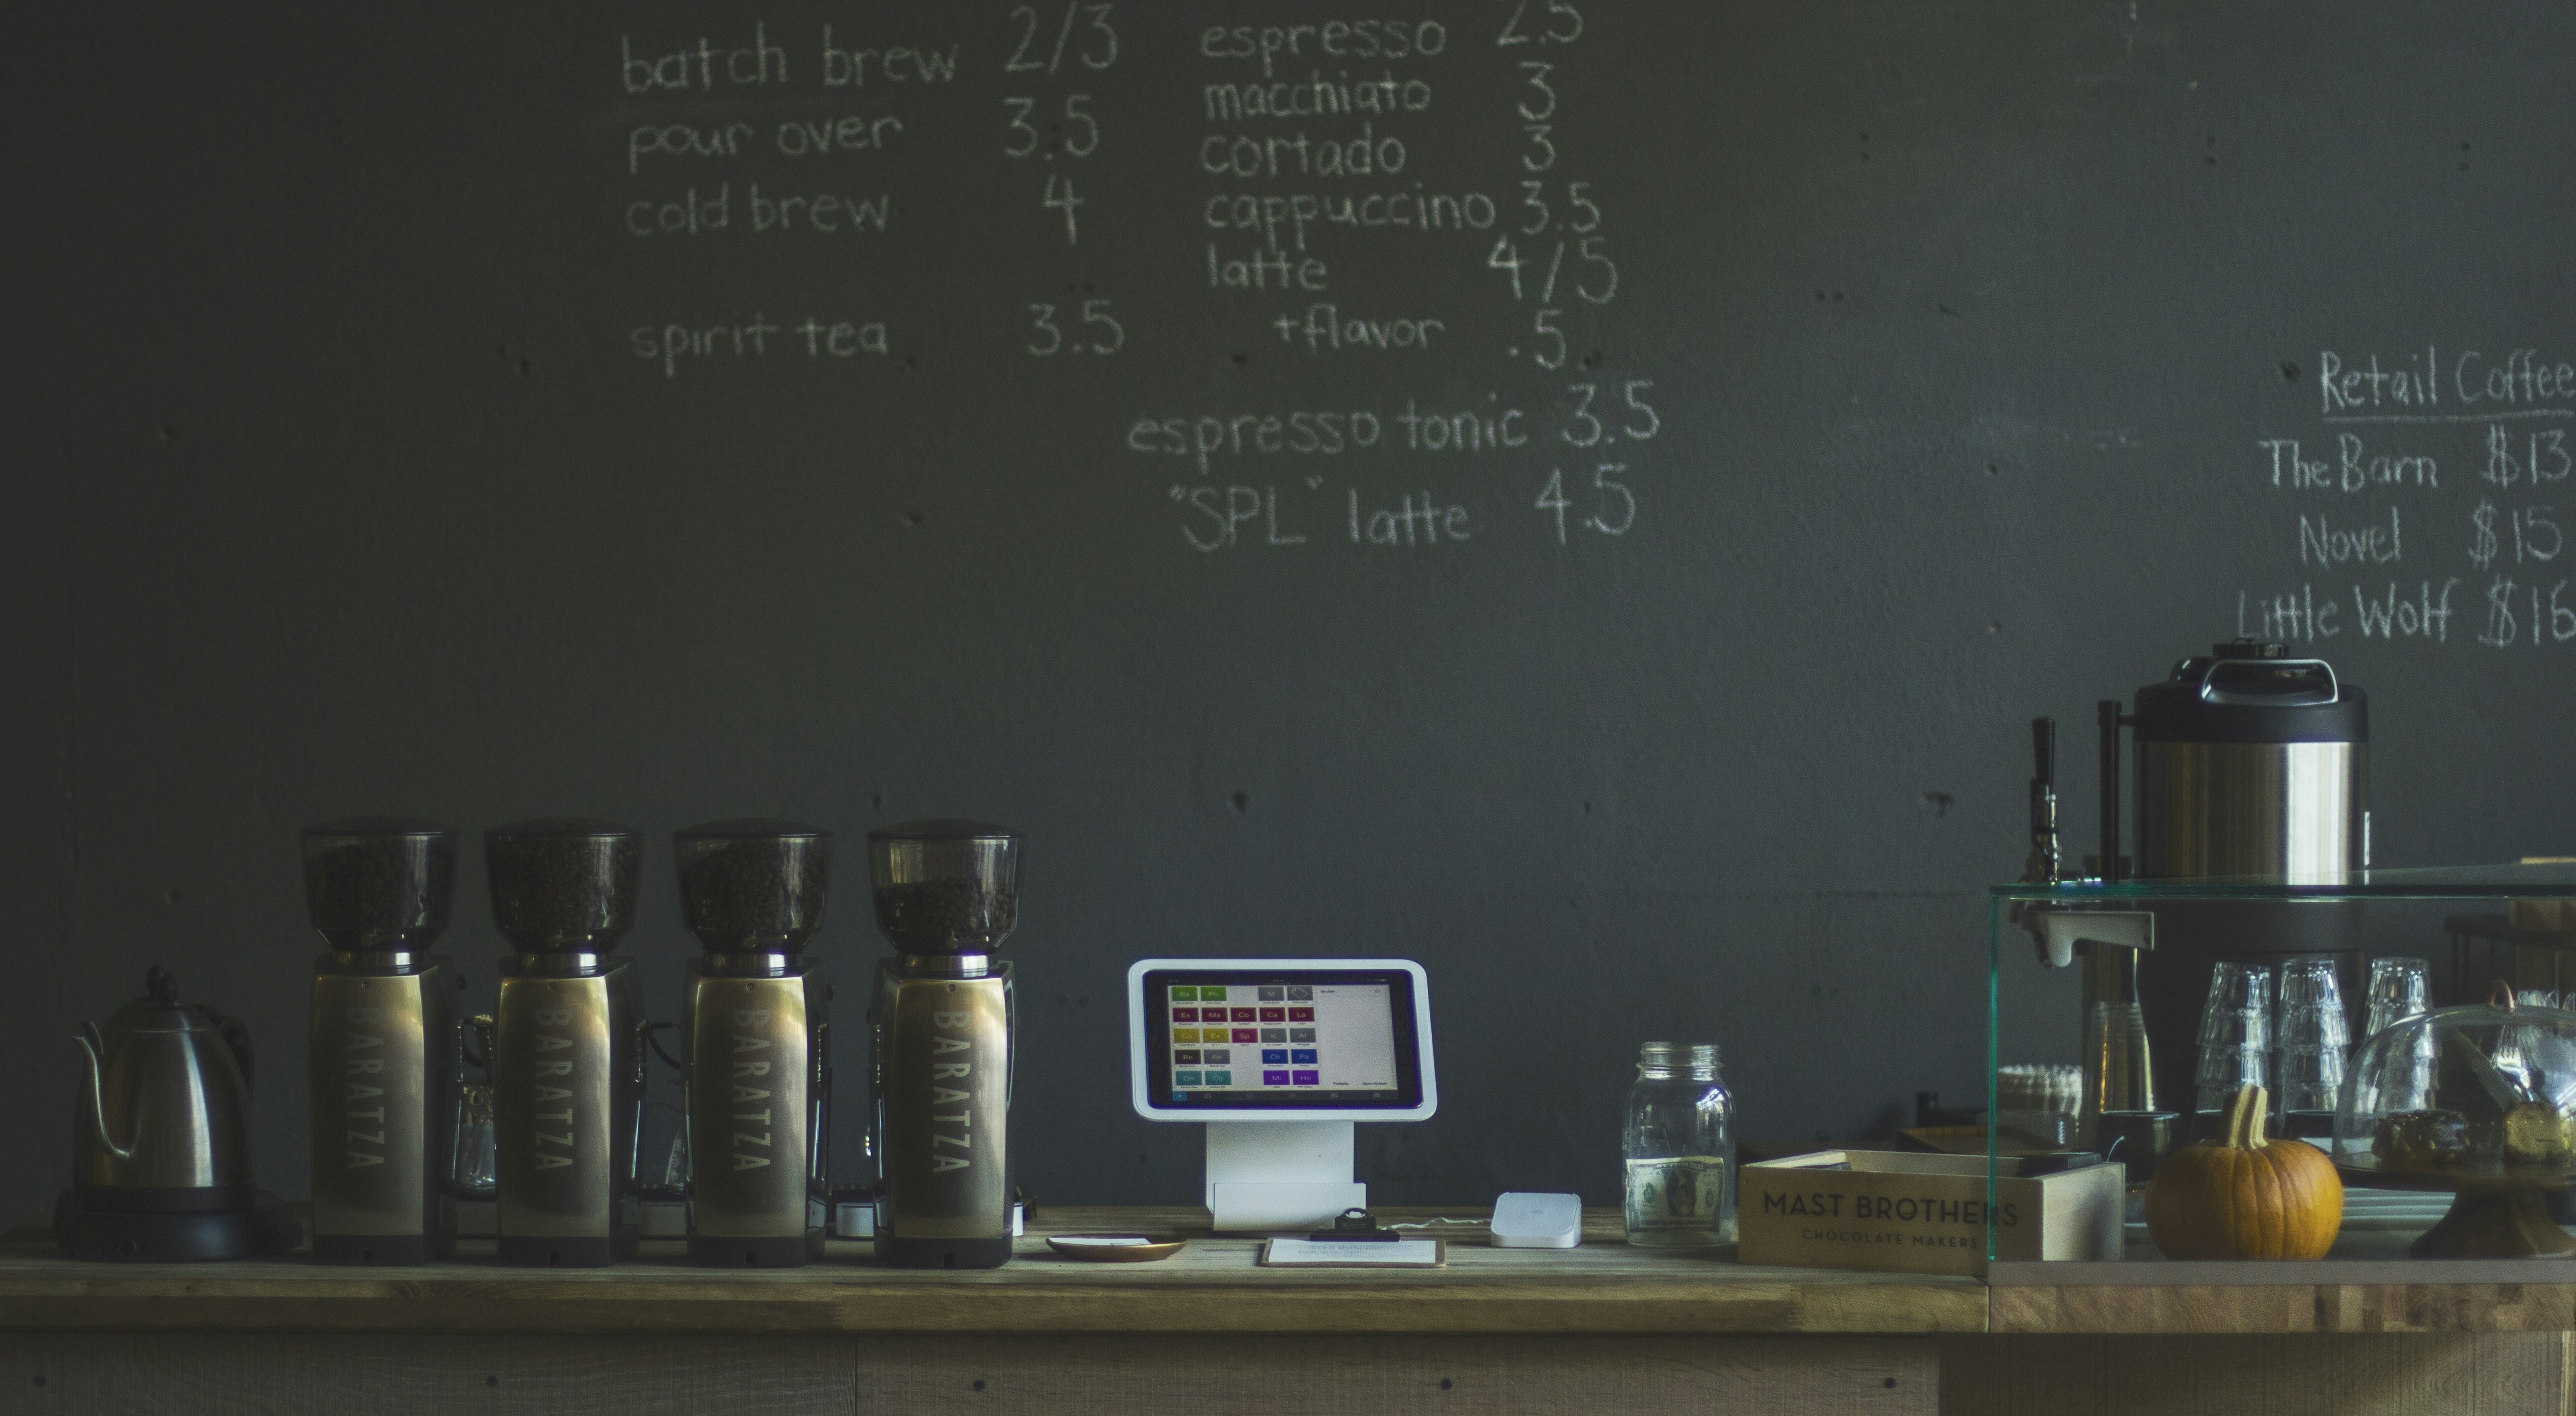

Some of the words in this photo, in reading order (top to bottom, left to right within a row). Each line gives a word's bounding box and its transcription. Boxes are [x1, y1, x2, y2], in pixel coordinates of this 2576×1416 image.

[621, 21, 787, 94] batch
[822, 24, 959, 87] brew
[1004, 0, 1118, 74] 2/3
[1200, 19, 1447, 78] espresso
[1203, 70, 1432, 120] macchiato
[1517, 60, 1557, 122] 3
[629, 122, 754, 174] pour
[776, 115, 904, 155] over
[1003, 94, 1100, 161] 3.5
[1200, 121, 1407, 177] cortado
[1522, 123, 1557, 172] 3
[626, 183, 729, 236] cold
[750, 183, 889, 233] brew
[1042, 174, 1085, 245] 4
[1204, 182, 1499, 252] cappuccino
[1520, 179, 1601, 236] 3.5
[1207, 244, 1328, 291] latte
[630, 313, 779, 378] spirit
[795, 316, 889, 357] tea
[1027, 299, 1125, 357] 3.5
[2318, 344, 2439, 414] Retail
[2454, 348, 2576, 403] Coffee
[1126, 411, 1381, 478] espresso
[1396, 391, 1529, 452] tonic
[1560, 379, 1661, 449] 3.5
[2257, 437, 2332, 490] The
[2337, 432, 2439, 493] Barn
[2480, 423, 2572, 490] $13
[1348, 487, 1471, 546] latte
[1534, 462, 1637, 546] 4.5
[2299, 505, 2402, 570] Novel
[2467, 497, 2563, 571] $15
[2238, 582, 2341, 644] Little
[2352, 576, 2461, 644] Wolf
[2476, 573, 2576, 650] $16
[346, 1006, 384, 1169] BARATZA
[535, 1008, 574, 1171] BARATZA
[733, 1009, 771, 1172] BARATZA
[932, 1010, 971, 1174] BARATZA
[1764, 1191, 1844, 1217] MAST
[1801, 1229, 1904, 1246] CHOCOLATE
[1911, 1234, 1979, 1250] MAKERS
